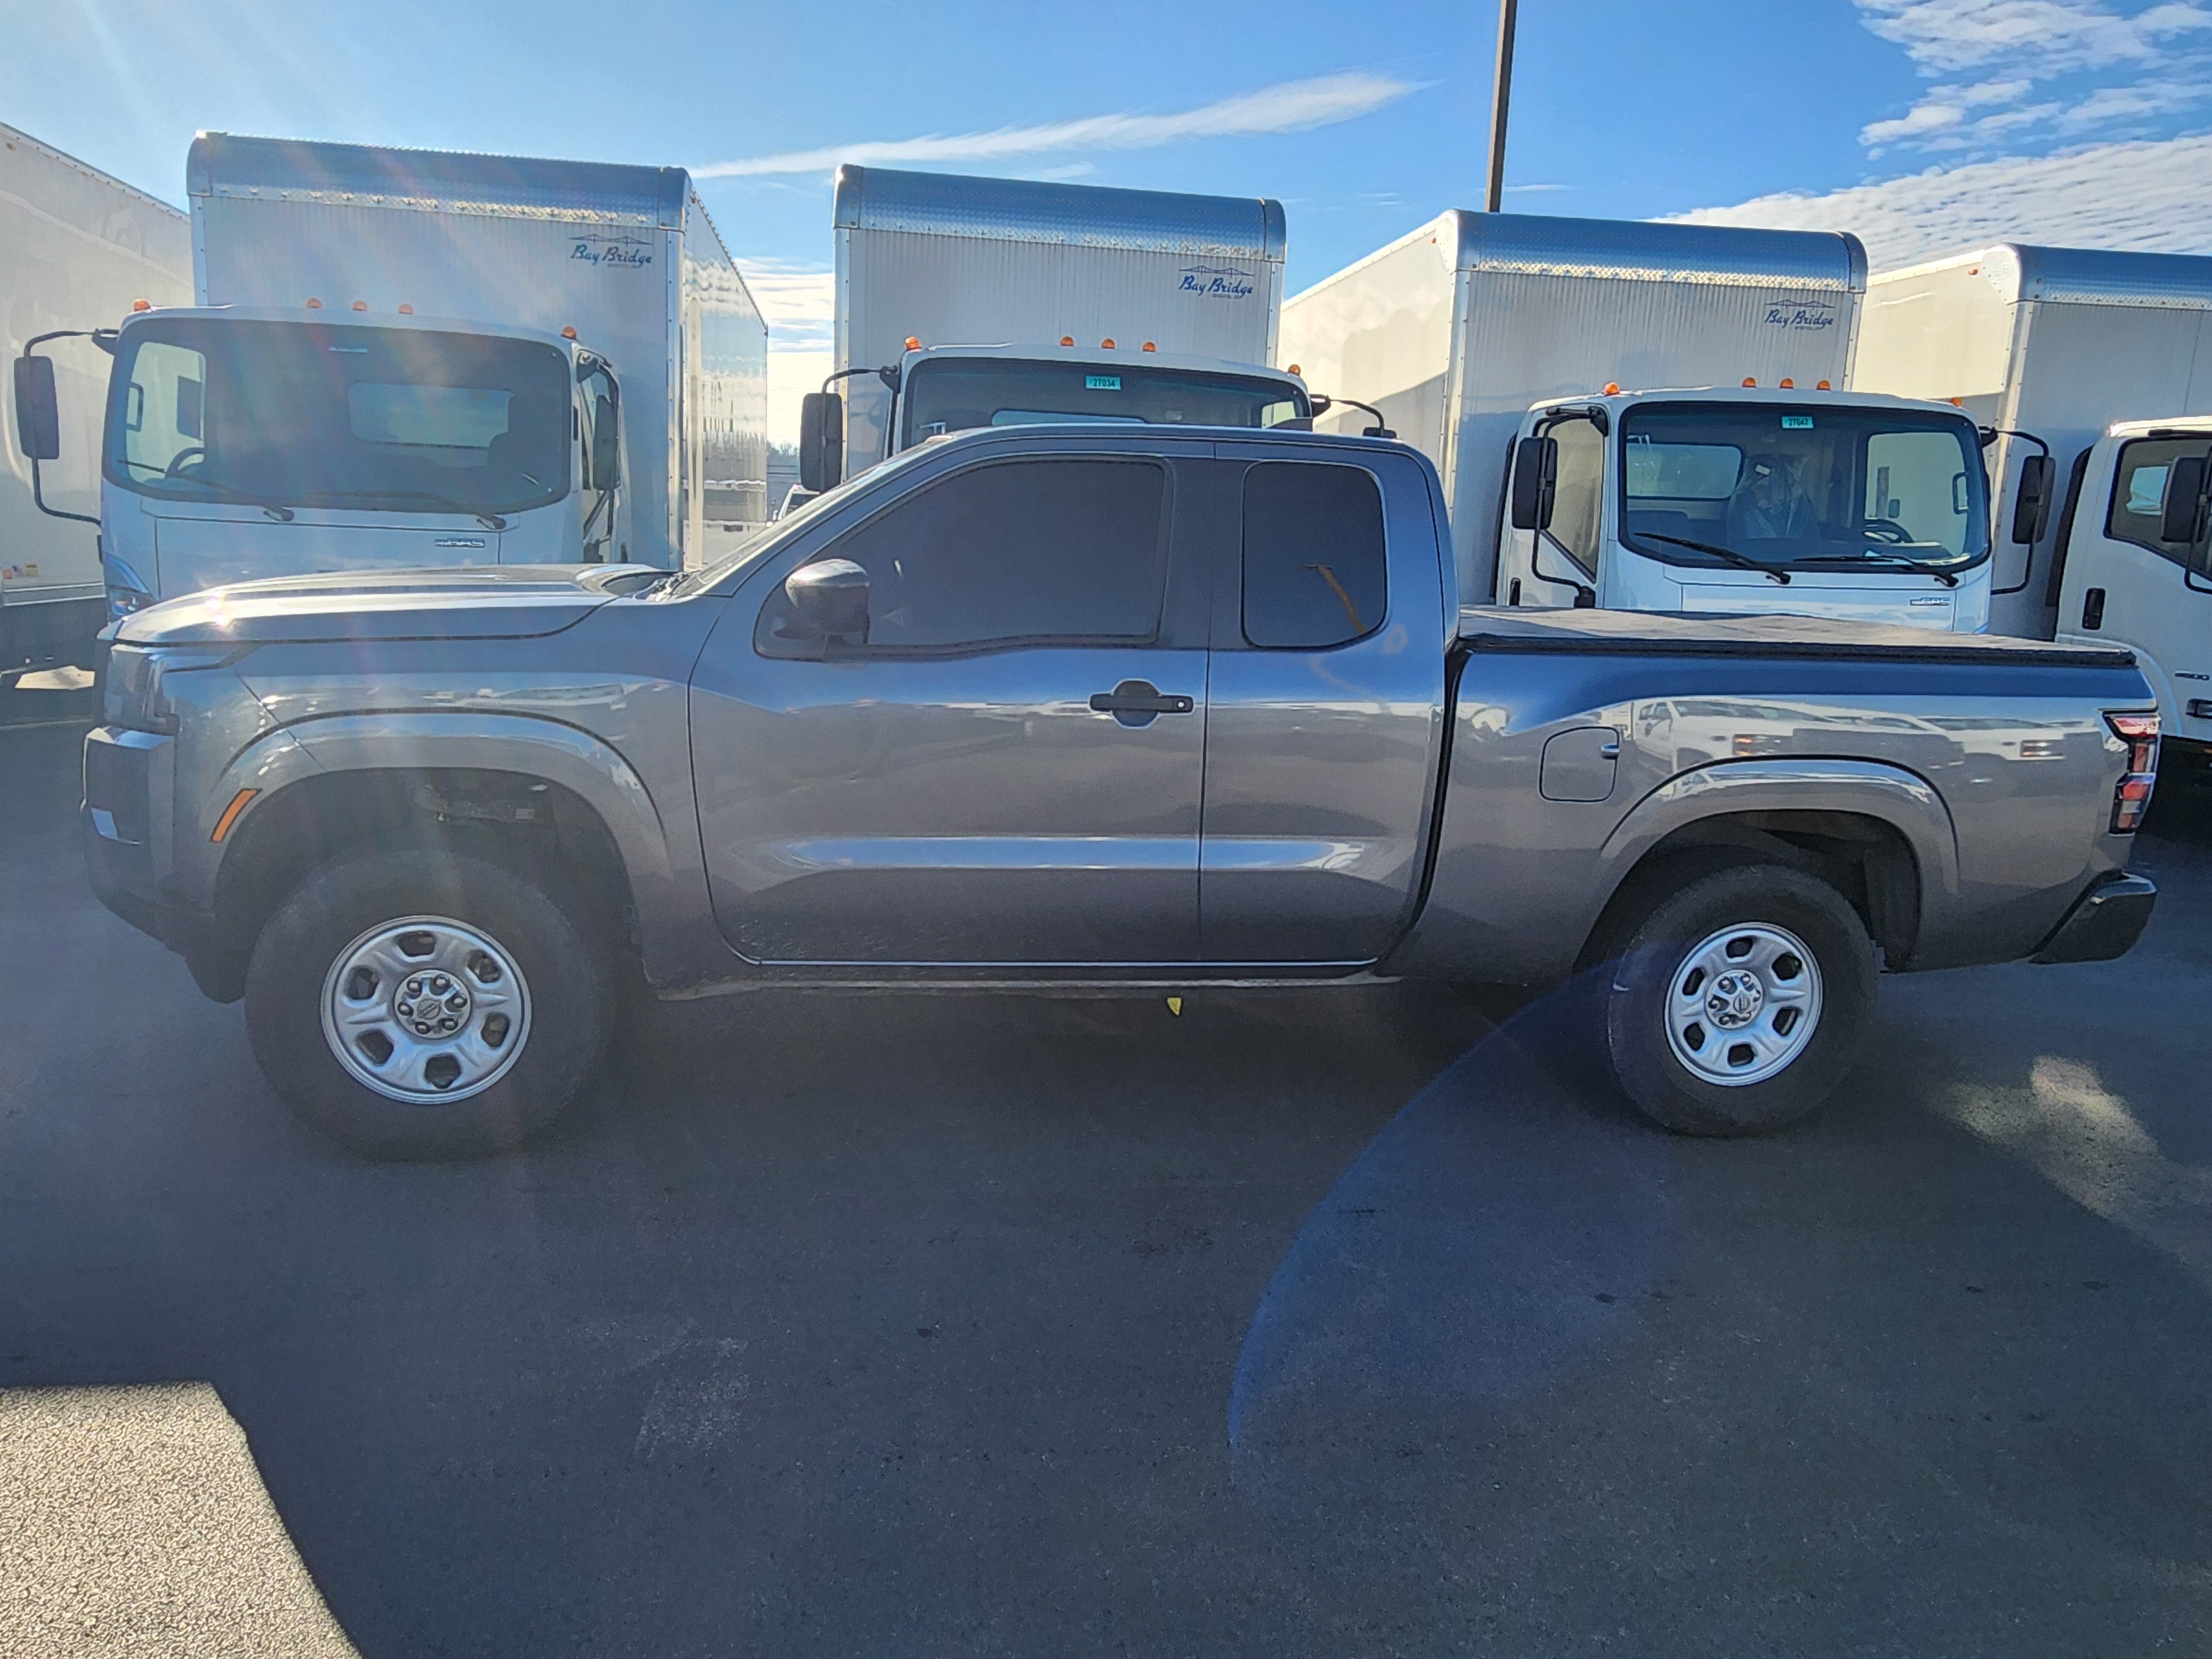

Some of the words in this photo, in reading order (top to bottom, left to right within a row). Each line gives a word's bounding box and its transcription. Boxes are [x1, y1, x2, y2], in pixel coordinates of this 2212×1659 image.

[571, 244, 600, 266] Bay
[602, 246, 653, 268] Bridge
[1178, 275, 1207, 296] Bay
[1207, 278, 1253, 299] Bridge
[1764, 309, 1790, 328] Bay
[1790, 310, 1834, 330] Bridge
[1093, 378, 1116, 387] 27034
